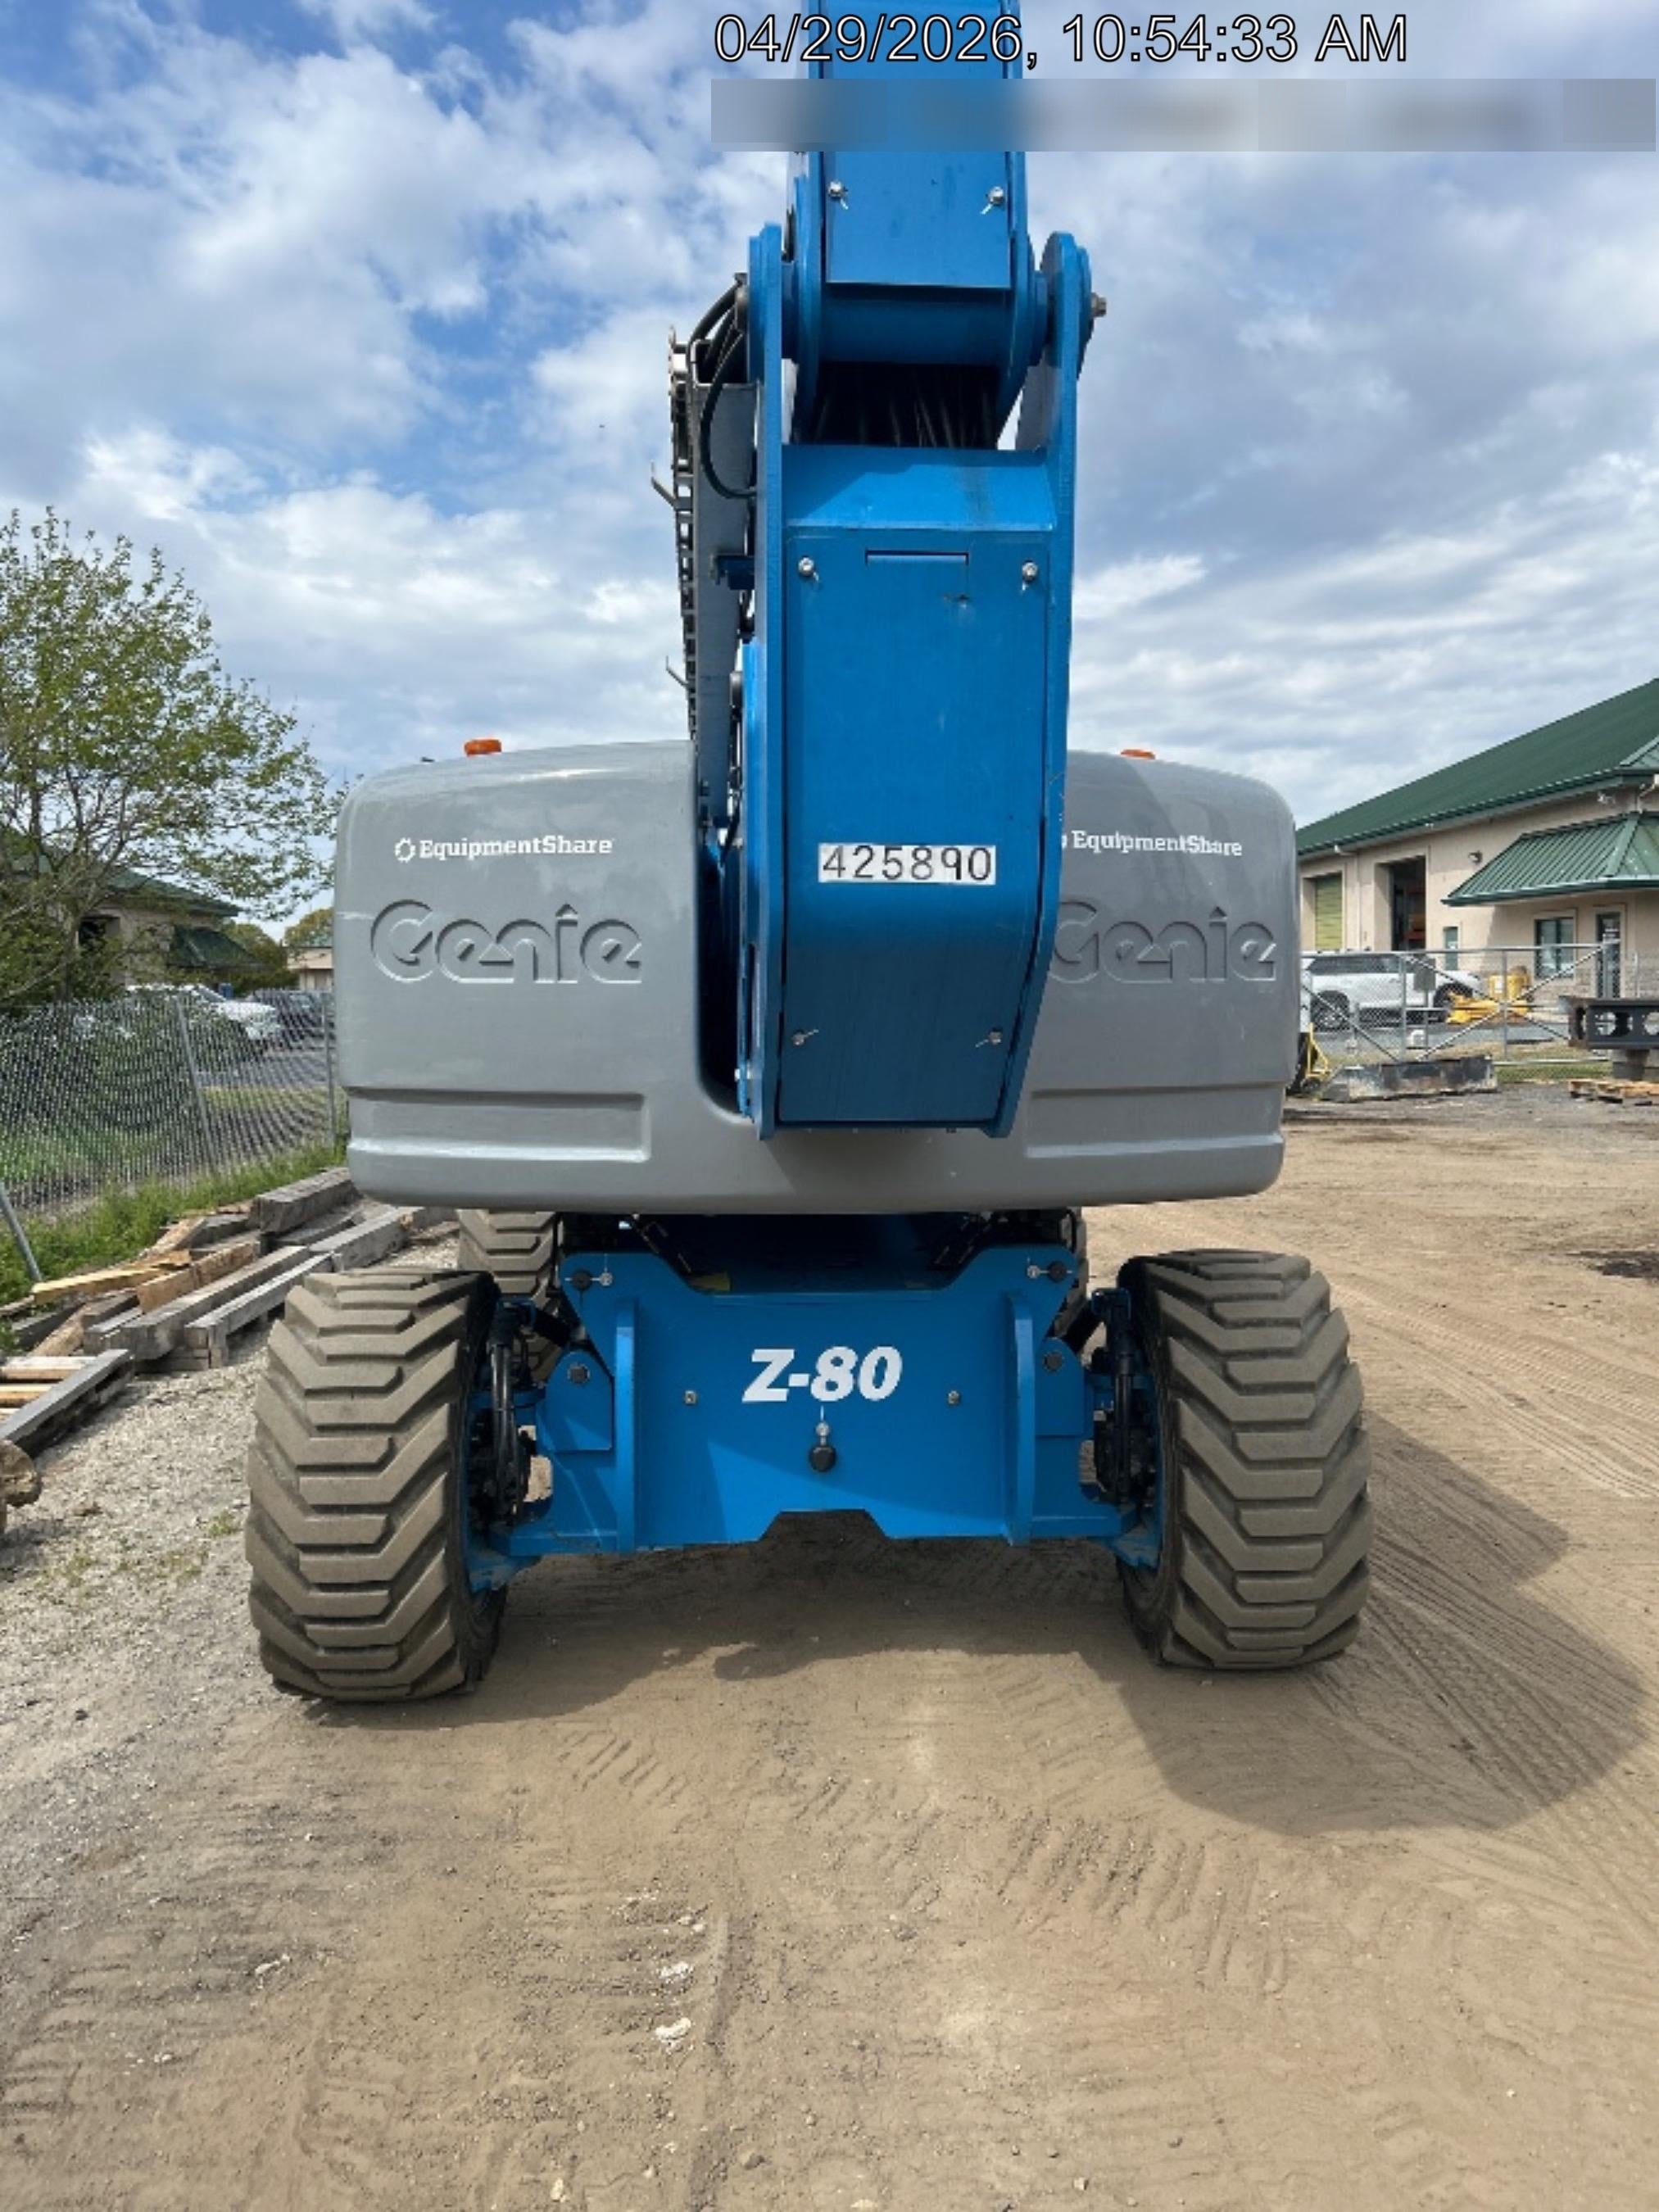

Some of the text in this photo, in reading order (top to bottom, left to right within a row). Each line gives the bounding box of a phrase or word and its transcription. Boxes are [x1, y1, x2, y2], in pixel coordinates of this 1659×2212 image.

[419, 835, 614, 861] EquipmentShare
[822, 845, 991, 881] 425890
[1071, 829, 1243, 856] EquipmentShare
[370, 899, 642, 984] Genie
[1049, 900, 1276, 984] Genie
[741, 1345, 902, 1403] Z-80
